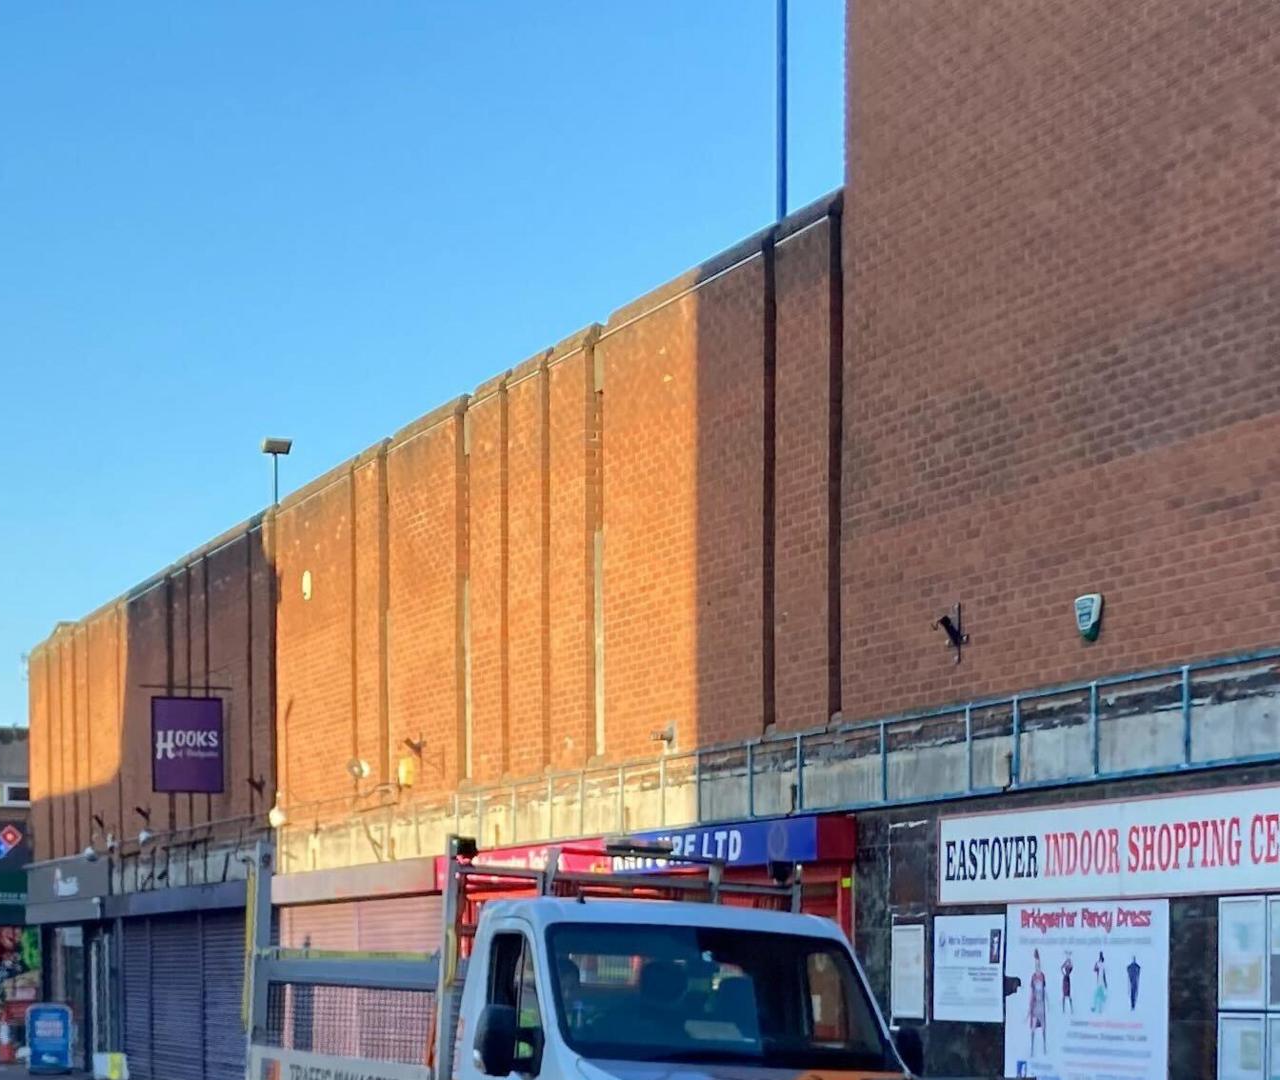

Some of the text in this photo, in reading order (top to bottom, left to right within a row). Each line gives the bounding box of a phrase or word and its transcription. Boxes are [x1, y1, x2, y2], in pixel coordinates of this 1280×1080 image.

[156, 730, 218, 759] HOOKS
[702, 829, 742, 862] LTD
[945, 835, 1039, 881] EASTOVER
[1044, 828, 1120, 876] INDOOR
[1127, 816, 1242, 872] SHOPPING
